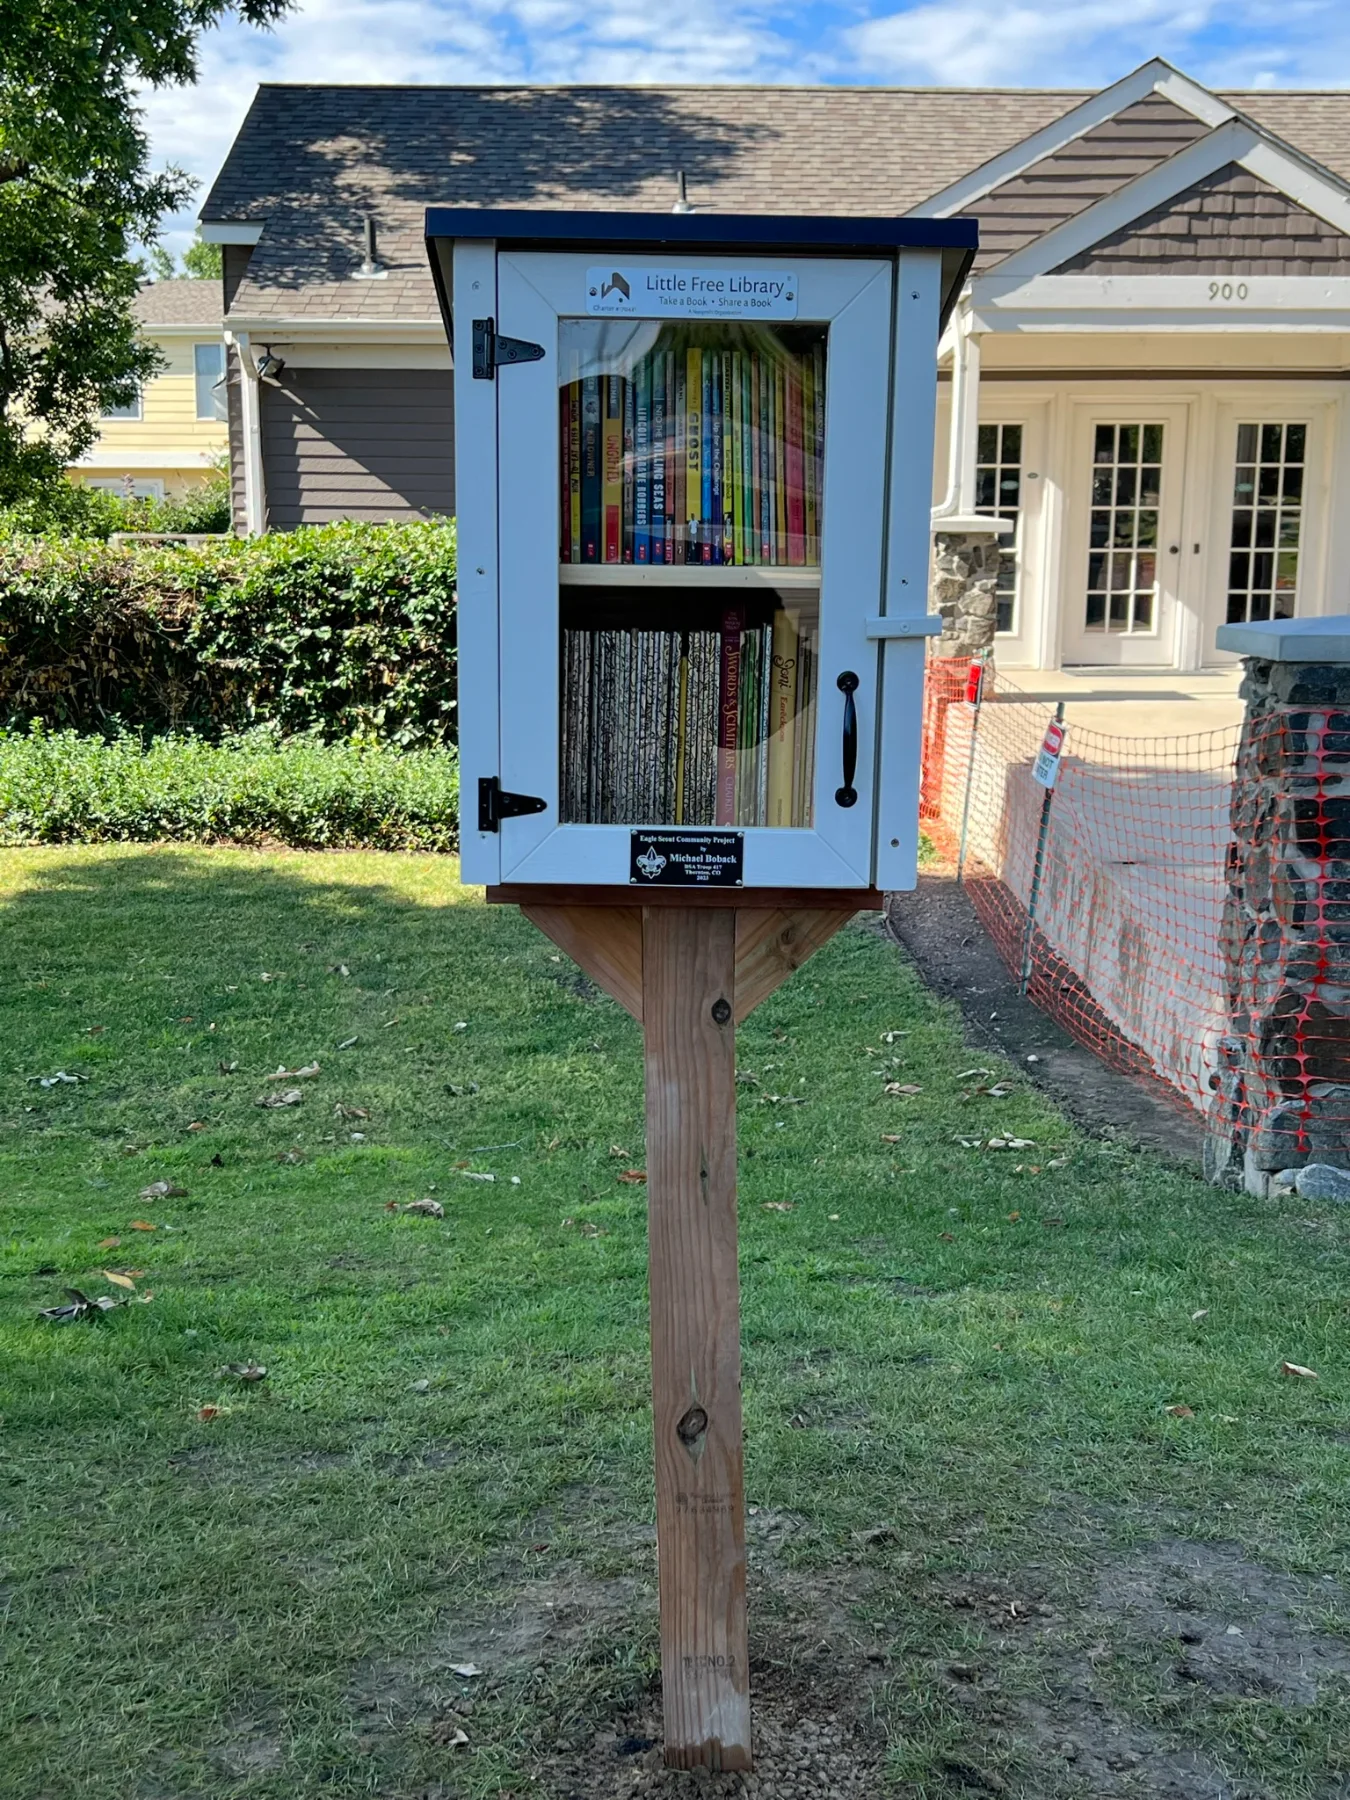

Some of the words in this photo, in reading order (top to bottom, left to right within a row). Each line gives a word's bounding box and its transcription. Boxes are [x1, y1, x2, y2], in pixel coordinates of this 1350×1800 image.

[646, 274, 686, 291] Little
[691, 276, 724, 292] Free
[729, 276, 784, 299] Library
[1208, 281, 1249, 301] 900
[658, 296, 678, 305] Take
[686, 296, 708, 306] Book
[718, 297, 742, 307] Share
[750, 298, 772, 308] Book
[571, 399, 580, 423] WORMS
[654, 404, 663, 424] INTO
[571, 427, 579, 446] FRIED
[637, 407, 647, 452] LINCOLN'S
[654, 425, 663, 438] THE
[713, 421, 720, 433] Up
[688, 412, 699, 472] GHOST
[571, 450, 579, 461] EAT
[587, 445, 596, 477] OWNER
[606, 434, 620, 483] UNGIFTED
[653, 441, 664, 480] KILLING
[571, 466, 579, 475] TO
[637, 455, 647, 484] GRAVE
[571, 478, 579, 493] HOW
[653, 483, 664, 510] SEAS
[637, 486, 647, 525] ROBBERS
[725, 645, 740, 700] SWORDS
[773, 654, 795, 692] Joni
[728, 701, 736, 710] &
[723, 704, 739, 769] SCIMITARS
[639, 835, 657, 843] Eagle
[676, 836, 711, 845] Community
[713, 837, 735, 845] Project
[669, 853, 703, 863] Michael
[705, 855, 737, 864] Boback
